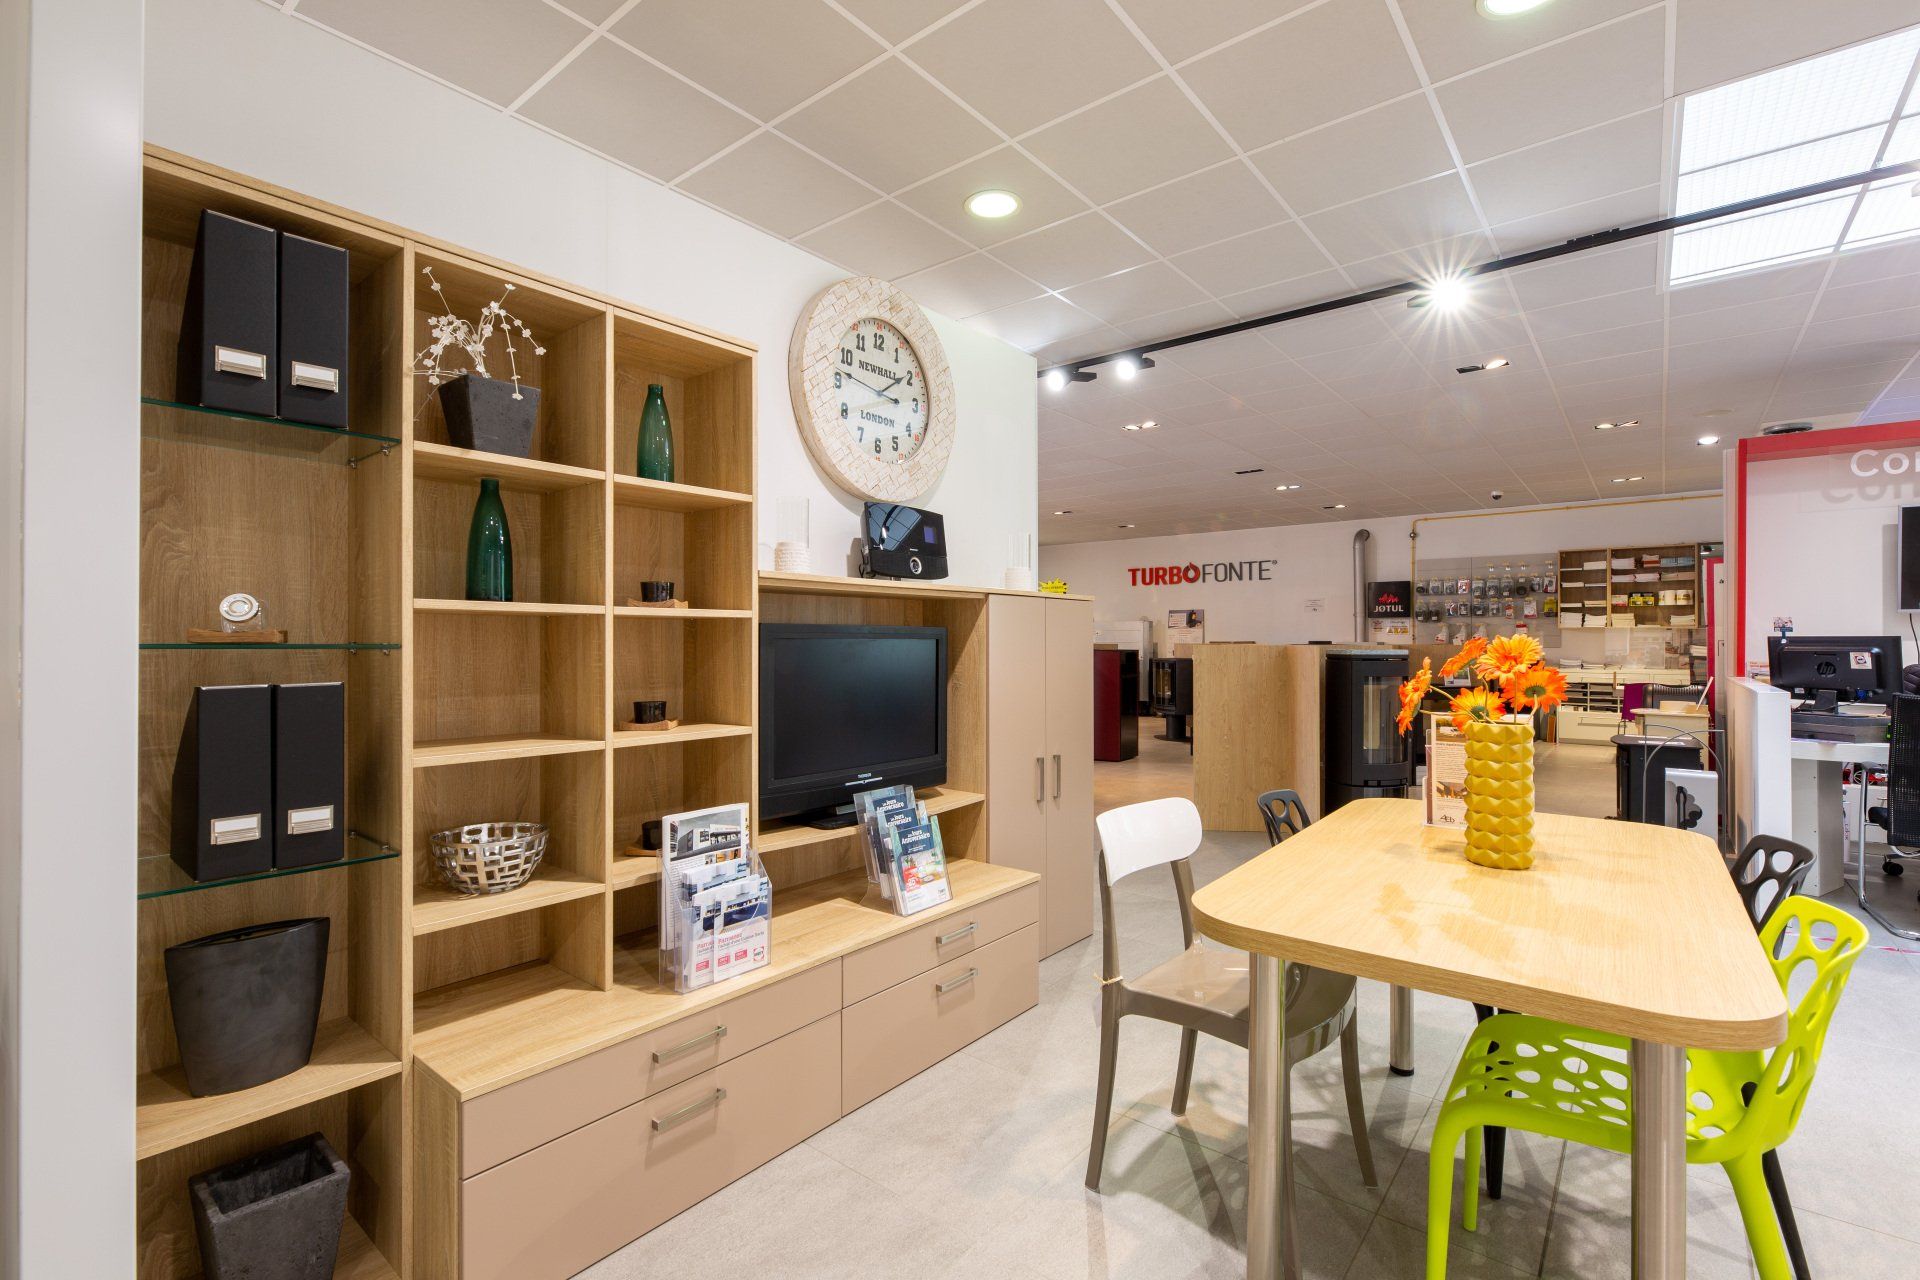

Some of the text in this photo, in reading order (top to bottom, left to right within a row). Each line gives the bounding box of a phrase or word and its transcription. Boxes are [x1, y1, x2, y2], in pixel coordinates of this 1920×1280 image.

[855, 333, 866, 352] 11
[873, 332, 885, 352] 12
[840, 347, 853, 366] 10
[894, 347, 899, 363] 1
[858, 359, 898, 381] NEWHALL
[906, 370, 913, 387] 2
[834, 371, 842, 389] 9
[840, 402, 849, 419] 8
[911, 397, 919, 414] 3
[860, 409, 895, 428] LONDON
[857, 426, 864, 443] 7
[905, 422, 911, 438] 4
[874, 437, 882, 454] 6
[891, 435, 899, 452] 5
[1850, 449, 1920, 477] Co
